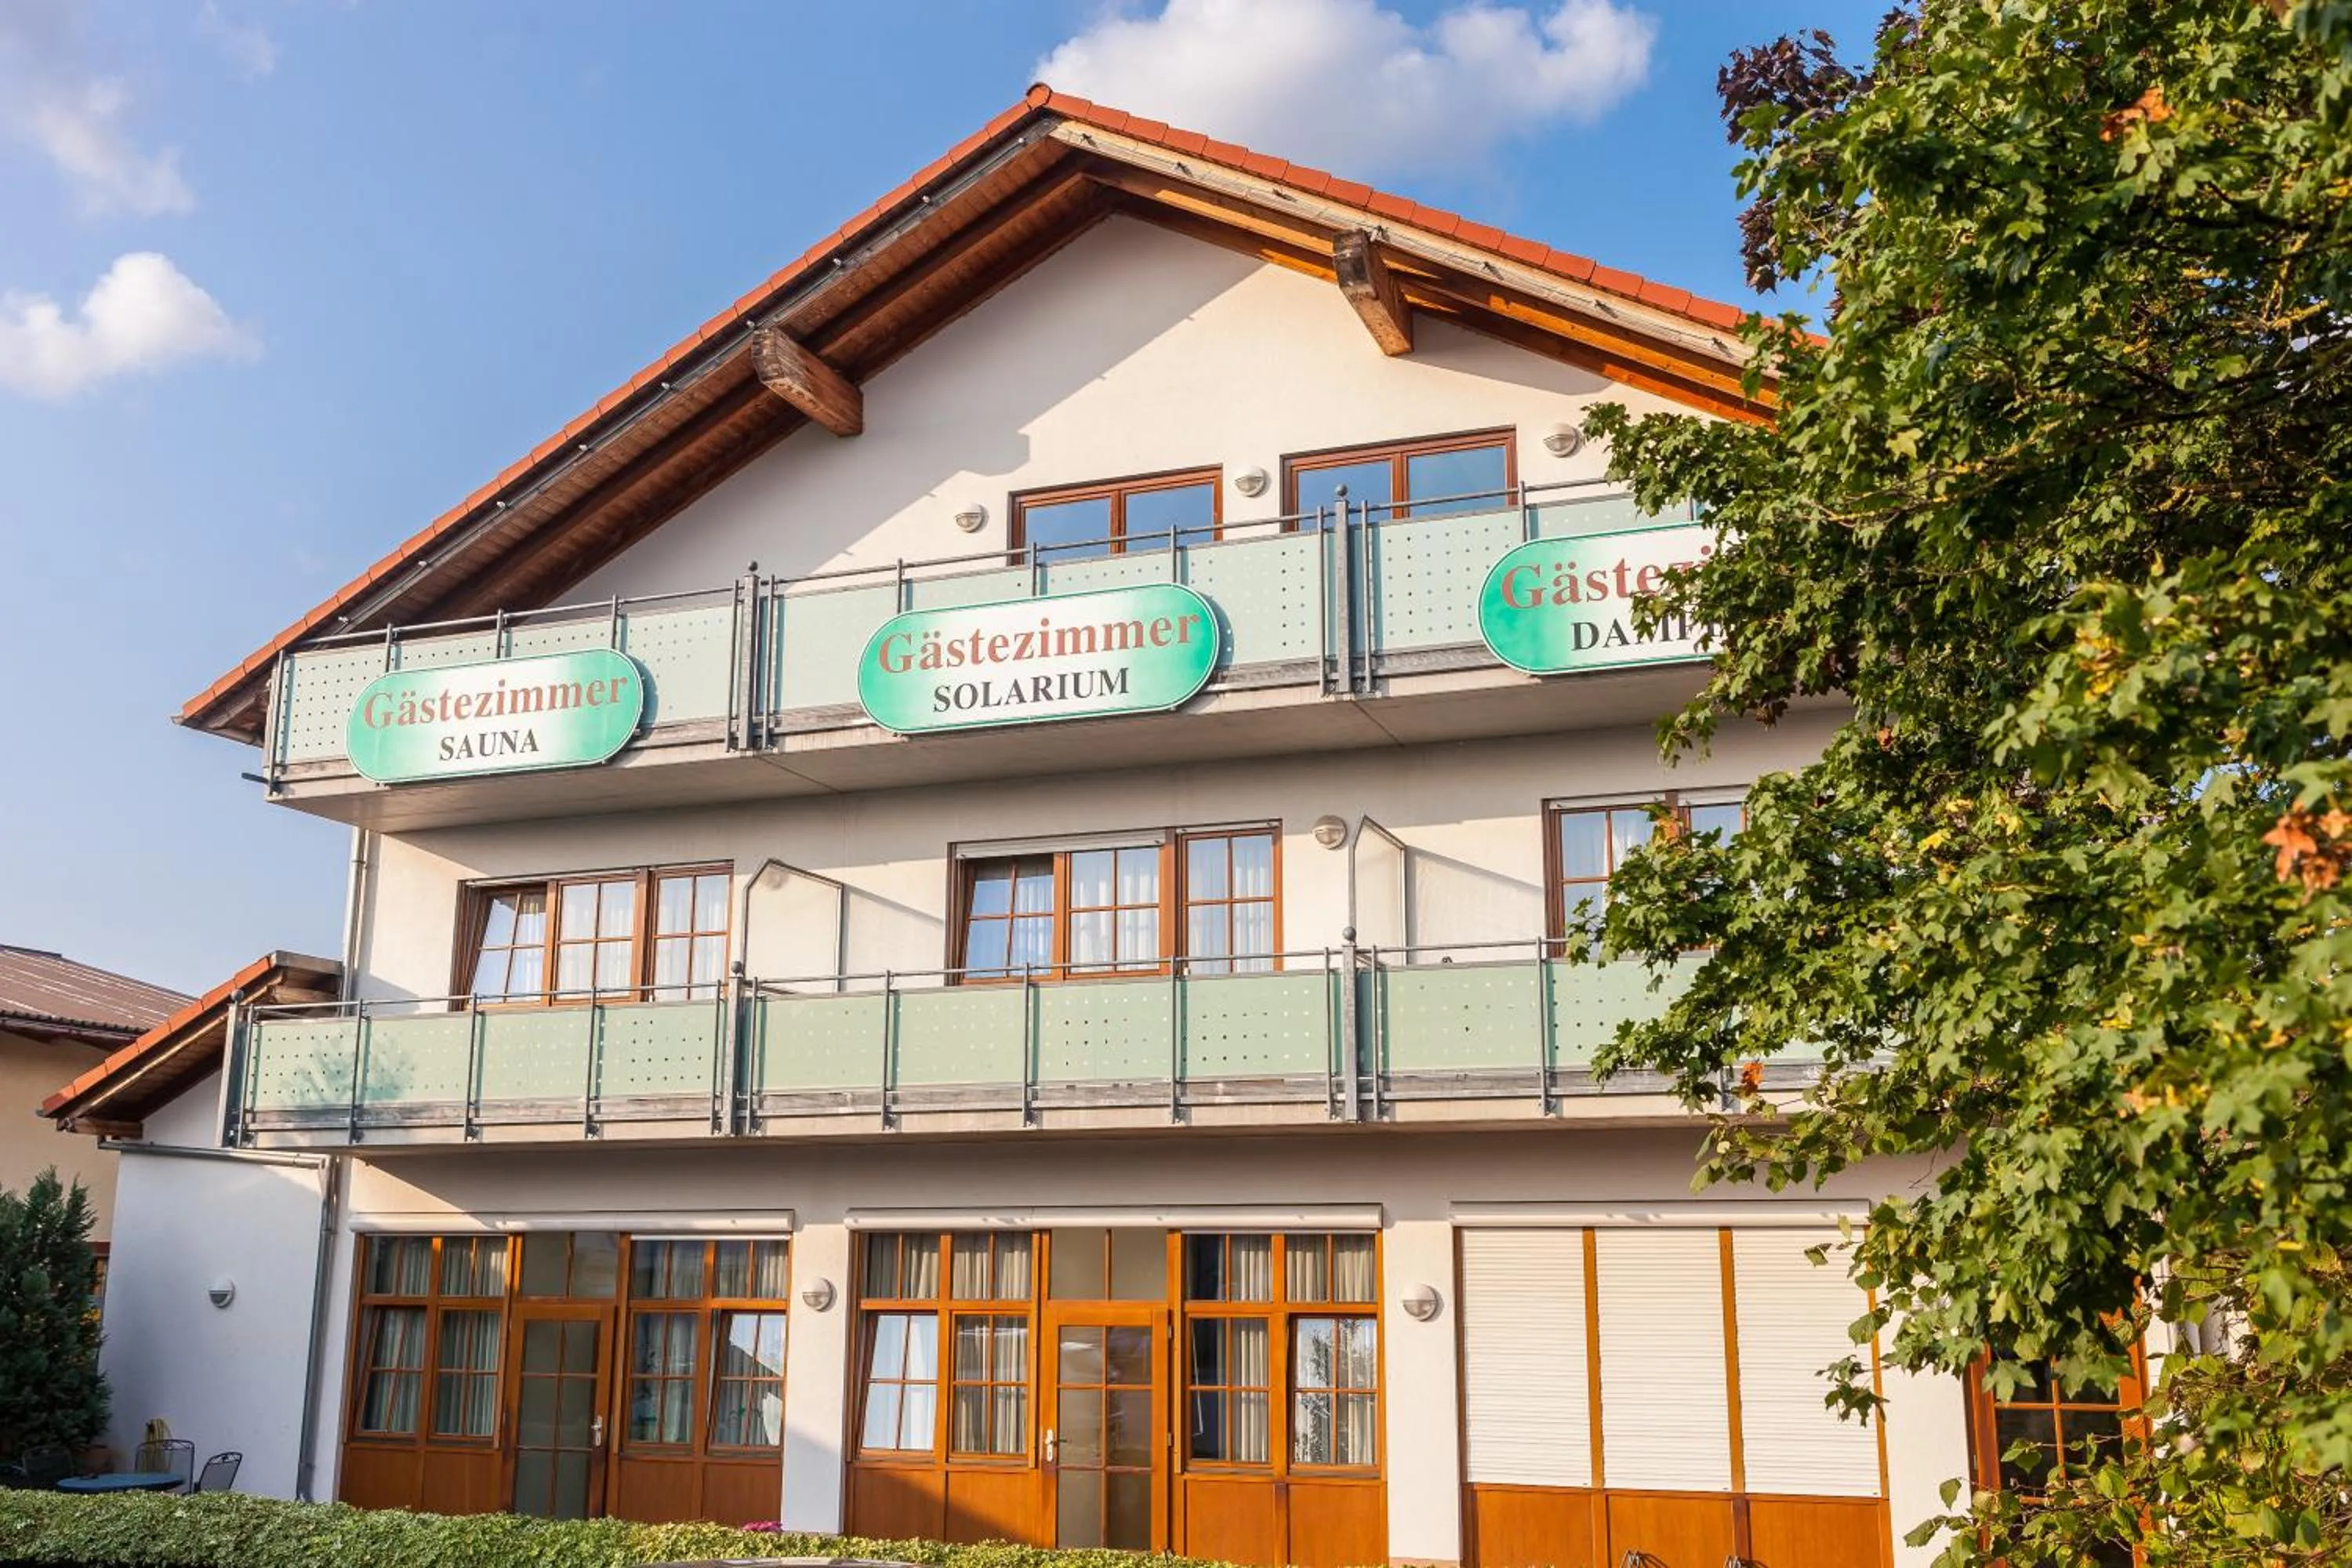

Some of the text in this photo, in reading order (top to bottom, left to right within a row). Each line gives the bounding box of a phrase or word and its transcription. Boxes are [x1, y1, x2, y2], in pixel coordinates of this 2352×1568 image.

[878, 612, 1200, 674] Gästezimmer
[363, 676, 628, 730] Gästezimmer
[933, 667, 1130, 713] SOLARIUM
[438, 728, 539, 761] SAUNA
